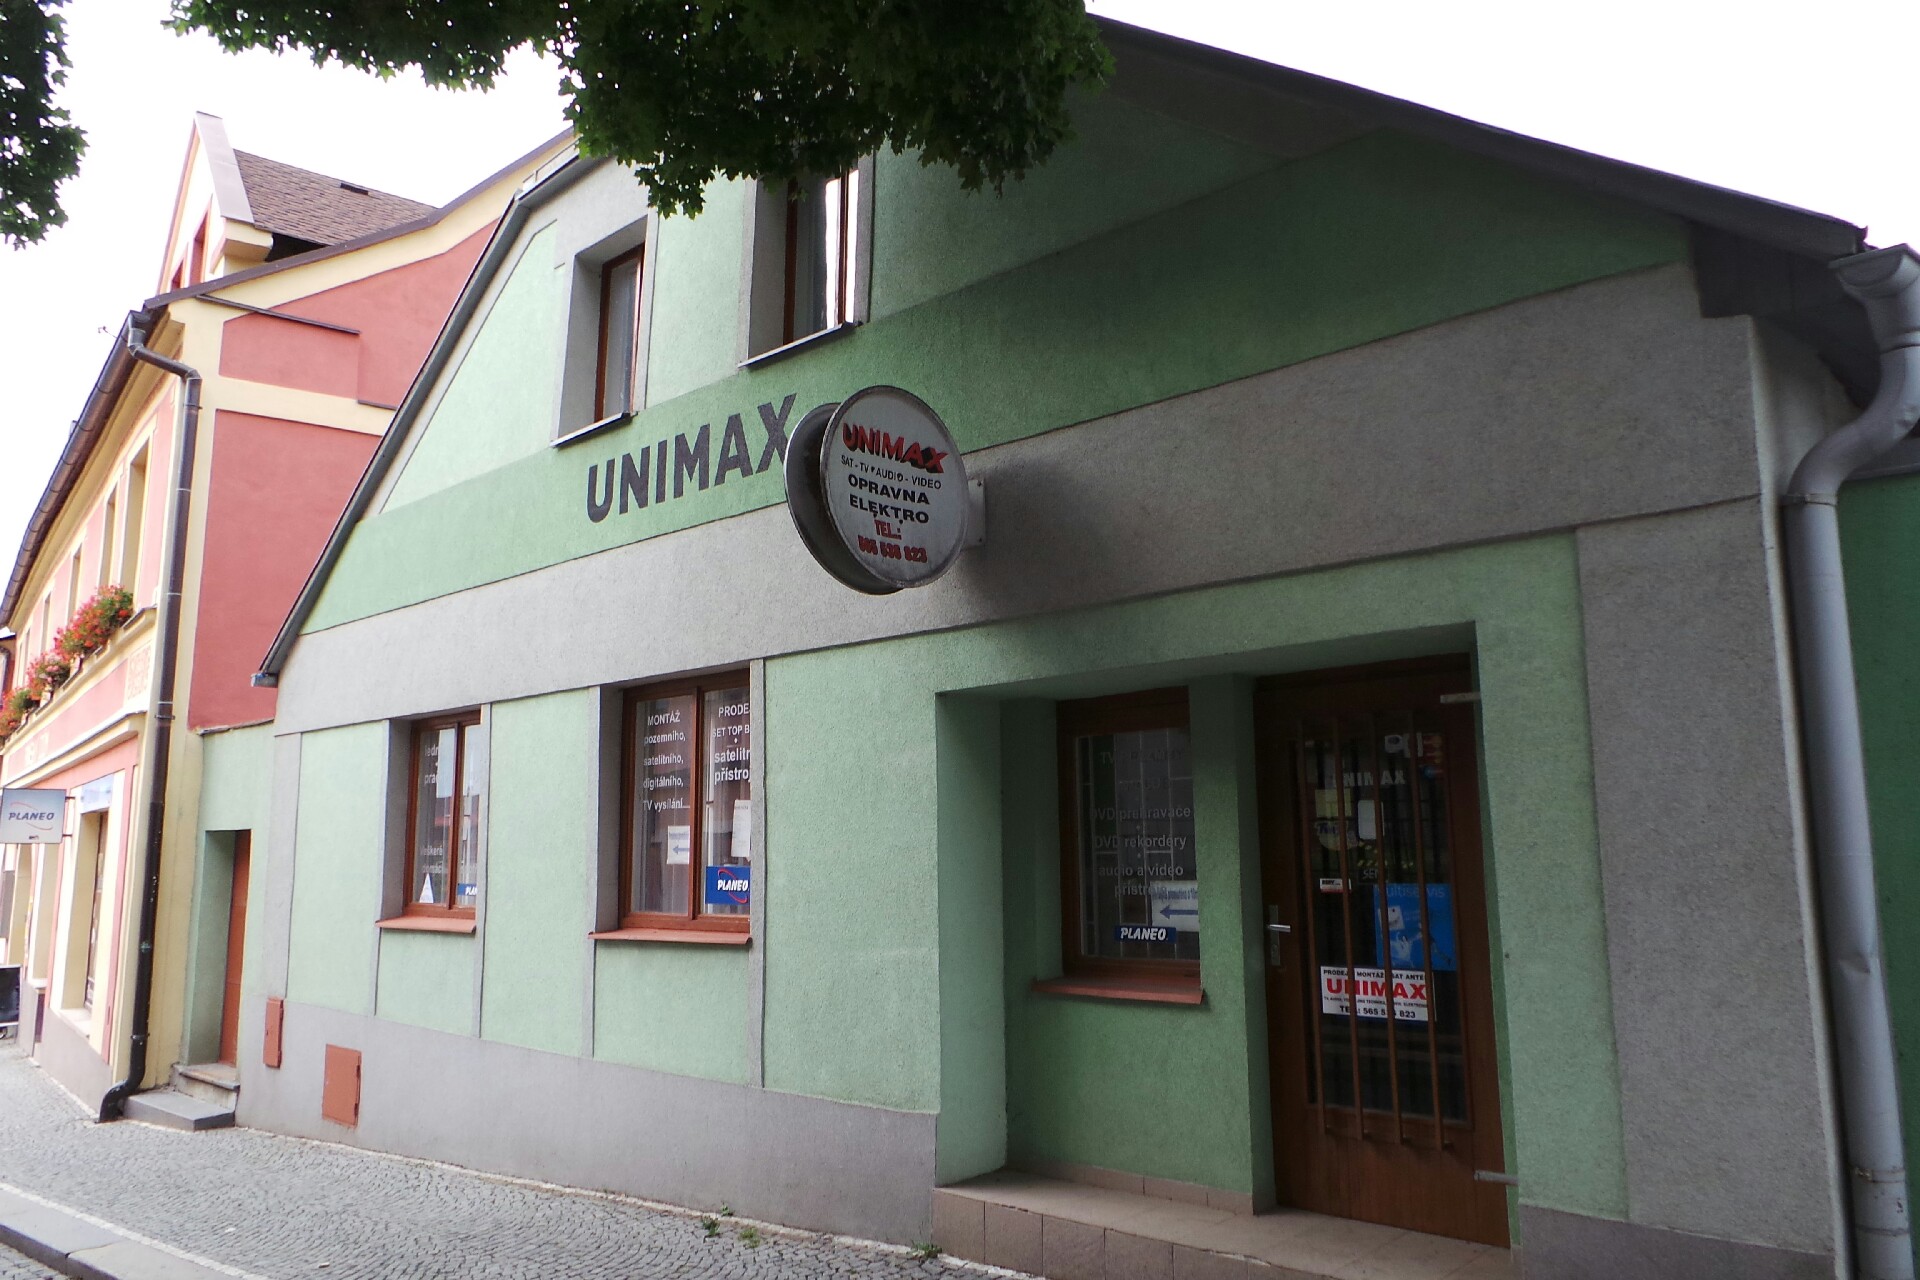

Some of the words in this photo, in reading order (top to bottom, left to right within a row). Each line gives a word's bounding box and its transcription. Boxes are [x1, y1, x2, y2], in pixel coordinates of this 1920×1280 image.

[842, 423, 949, 474] UNIMAX
[587, 393, 797, 523] UNIMAX
[912, 475, 941, 489] VIDEO
[848, 474, 930, 505] OPRAVNA
[850, 494, 929, 524] ELEKTRO
[719, 703, 750, 718] PRODE
[728, 725, 743, 736] TOP
[9, 812, 55, 821] PLANEO
[1148, 863, 1184, 876] video
[717, 879, 749, 892] PLANEO
[1120, 927, 1166, 941] PLANEO
[1326, 978, 1427, 1000] UNIMAX
[1363, 1007, 1379, 1015] 565
[1400, 1010, 1416, 1018] 823
